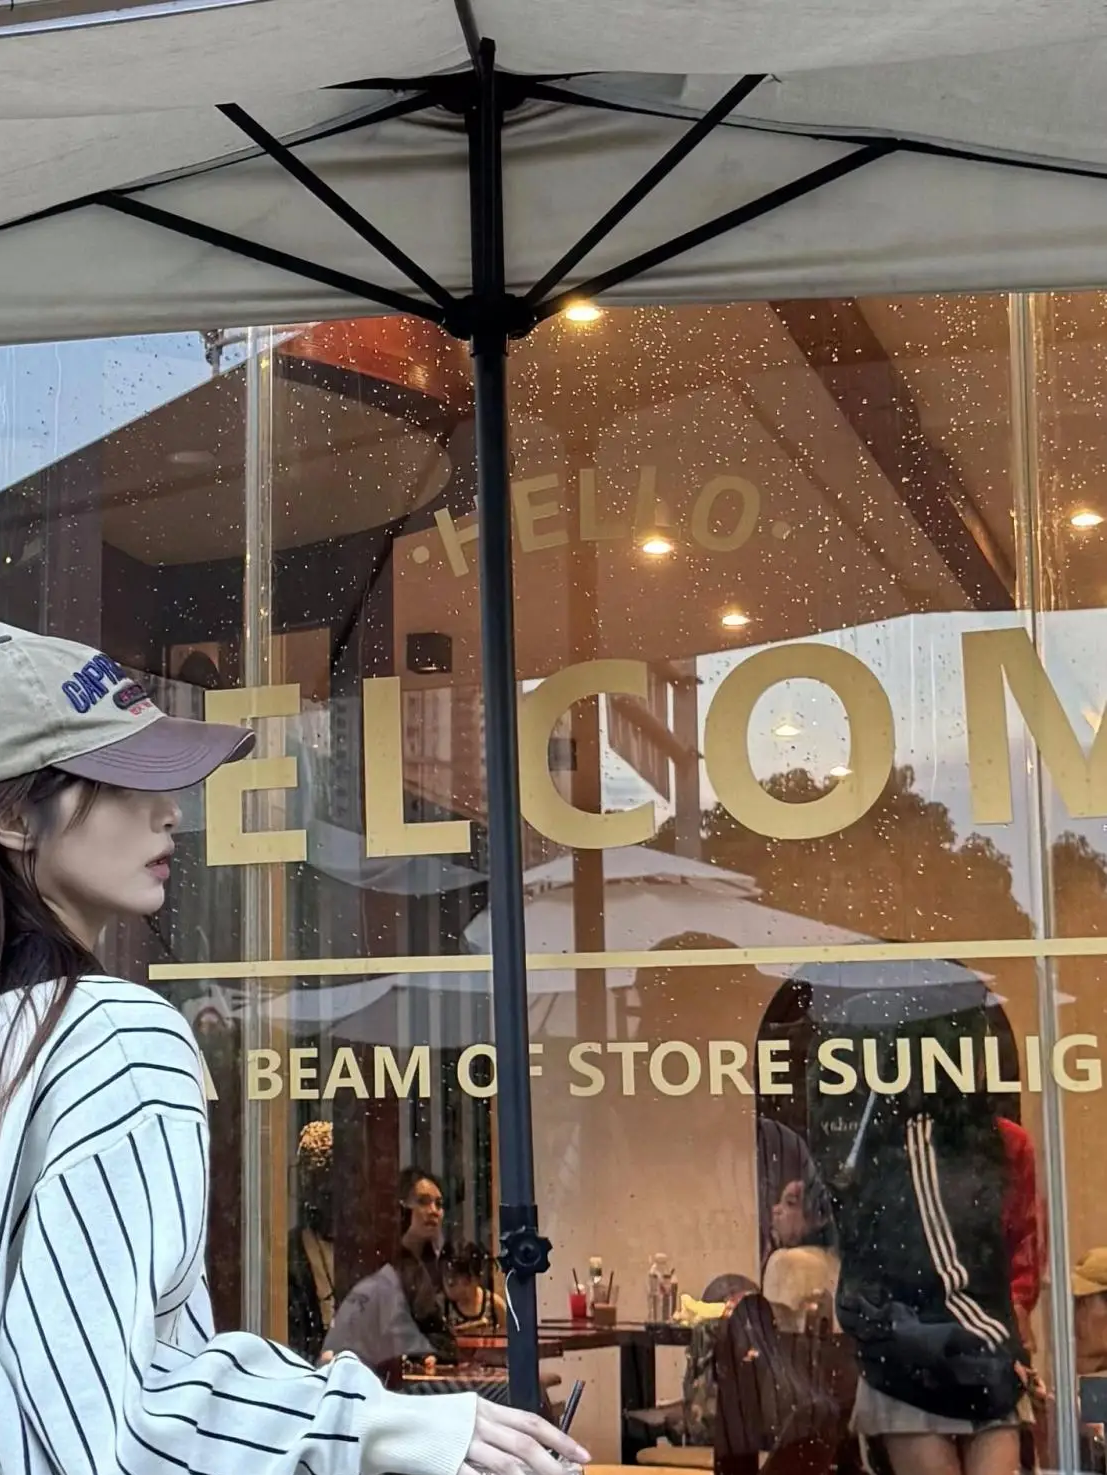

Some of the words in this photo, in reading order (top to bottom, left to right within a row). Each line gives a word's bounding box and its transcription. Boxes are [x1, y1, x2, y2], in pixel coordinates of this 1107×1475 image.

[247, 1043, 431, 1101] BEAM
[568, 1039, 793, 1097] STORE
[817, 1034, 1103, 1096] SUNLIG
